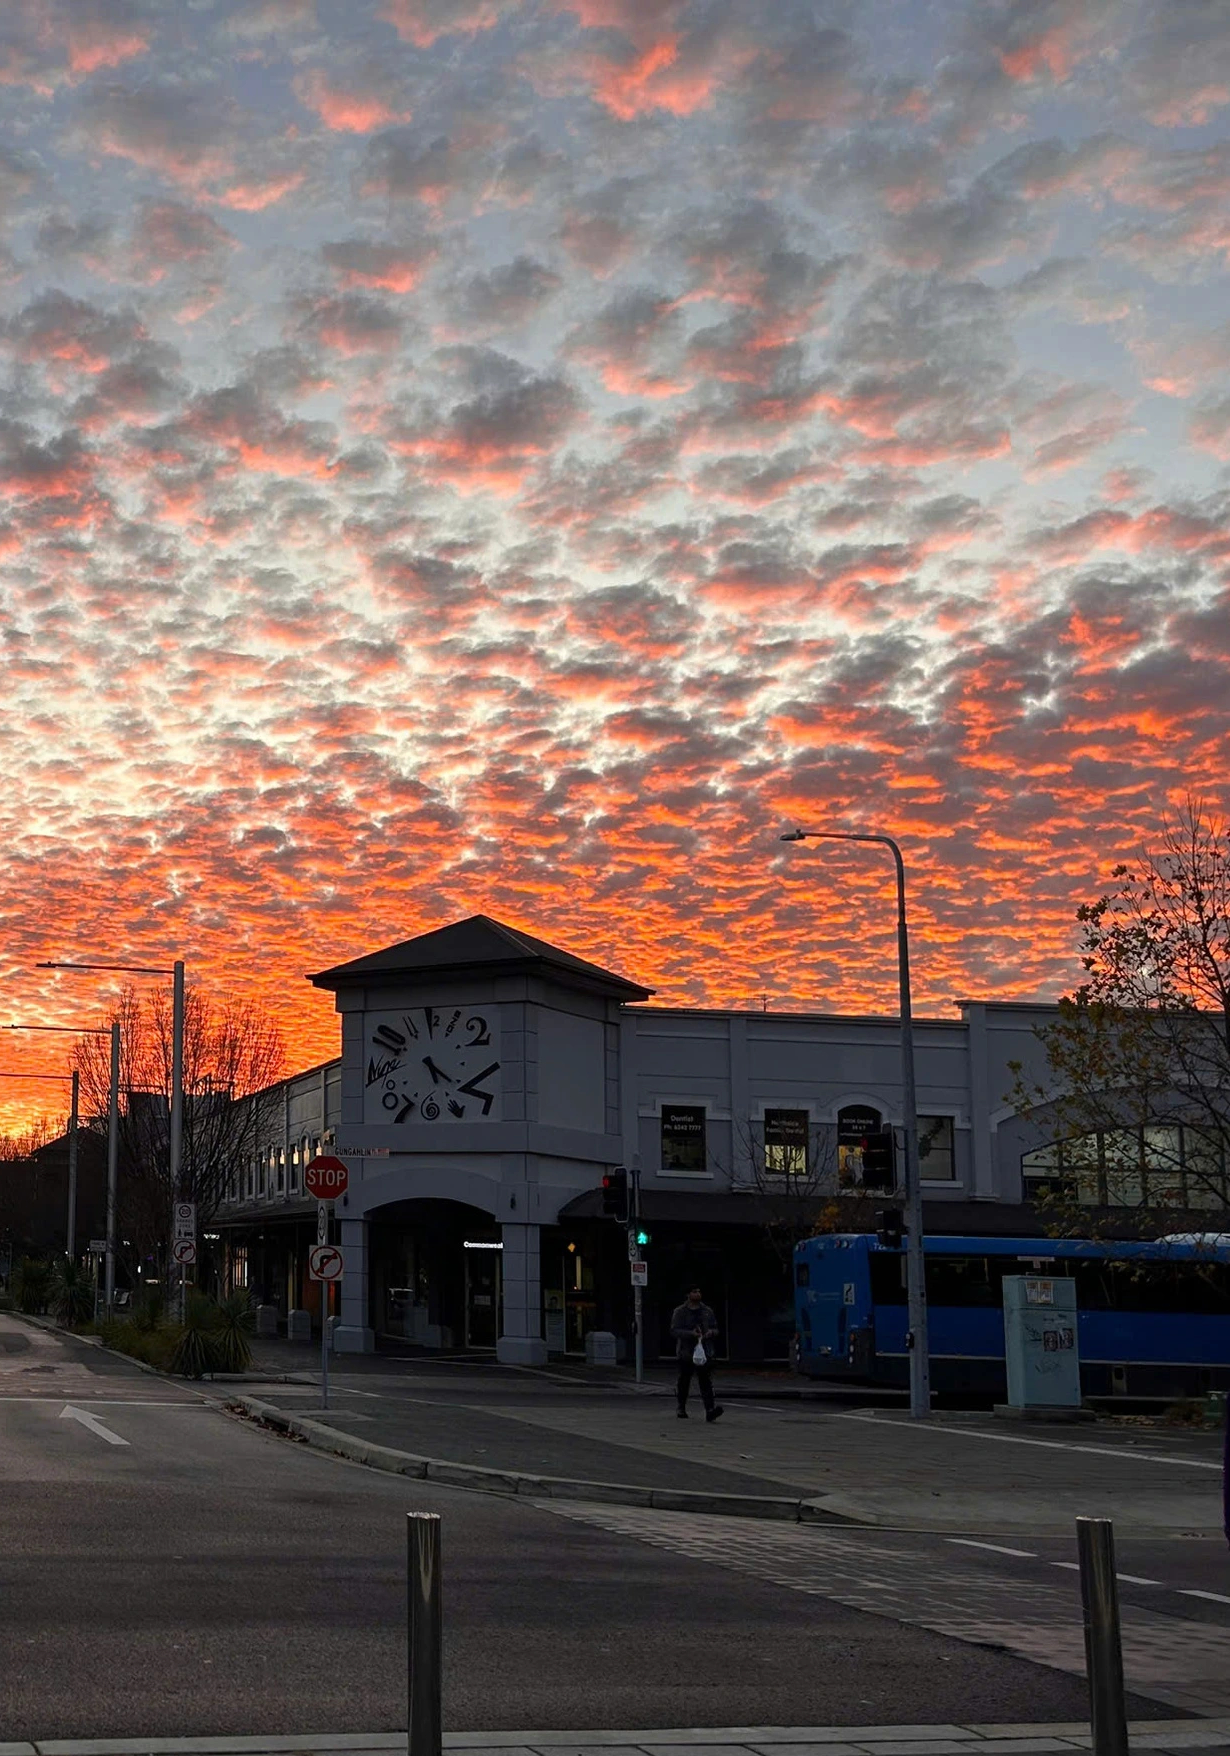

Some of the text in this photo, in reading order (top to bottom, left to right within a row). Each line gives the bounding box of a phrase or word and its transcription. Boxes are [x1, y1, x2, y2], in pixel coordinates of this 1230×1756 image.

[465, 1016, 491, 1047] 2
[335, 1147, 370, 1156] GUNGAHLIN
[307, 1168, 347, 1187] STOP
